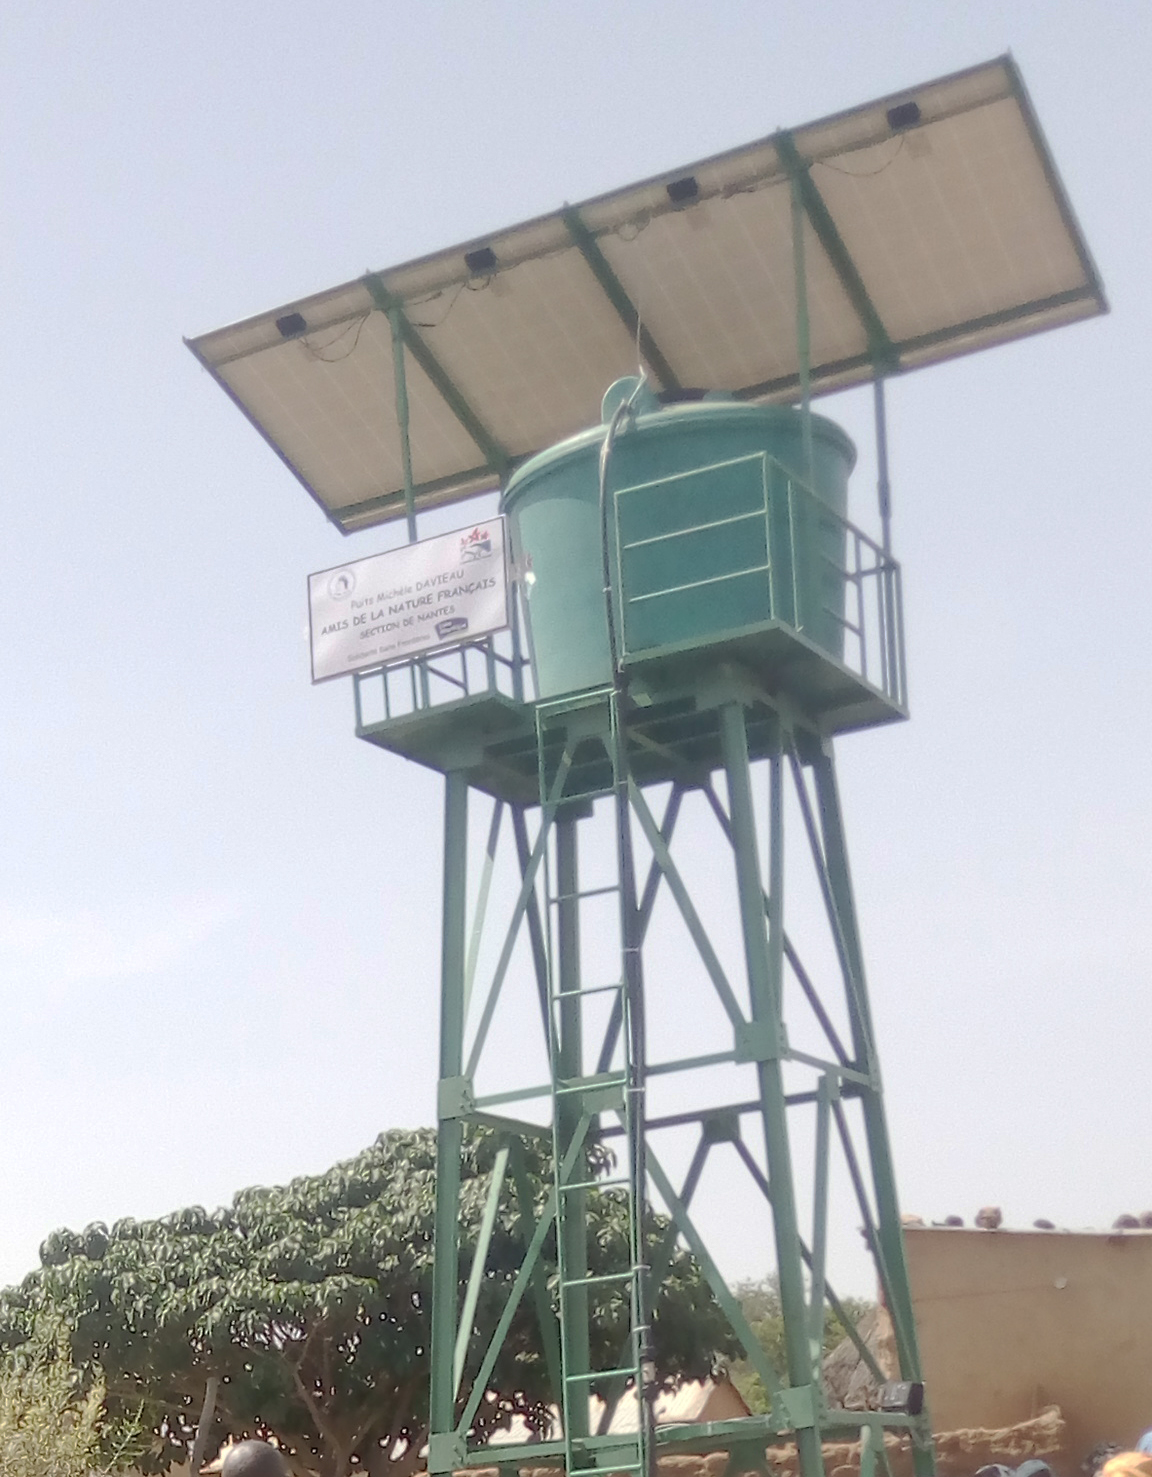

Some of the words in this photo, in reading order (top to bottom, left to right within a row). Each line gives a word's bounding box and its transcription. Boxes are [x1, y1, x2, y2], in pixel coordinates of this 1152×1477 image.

[321, 619, 349, 636] AMIS
[353, 614, 367, 627] DE
[370, 608, 384, 621] LA
[388, 596, 433, 616] NATURE
[437, 577, 497, 602] FRANÇAIS
[351, 594, 373, 609] Puits
[377, 585, 413, 603] Michèle
[416, 570, 464, 591] DAVIEAU
[359, 623, 400, 640] SECTION
[403, 615, 413, 626] DE
[417, 605, 456, 622] NANTES
